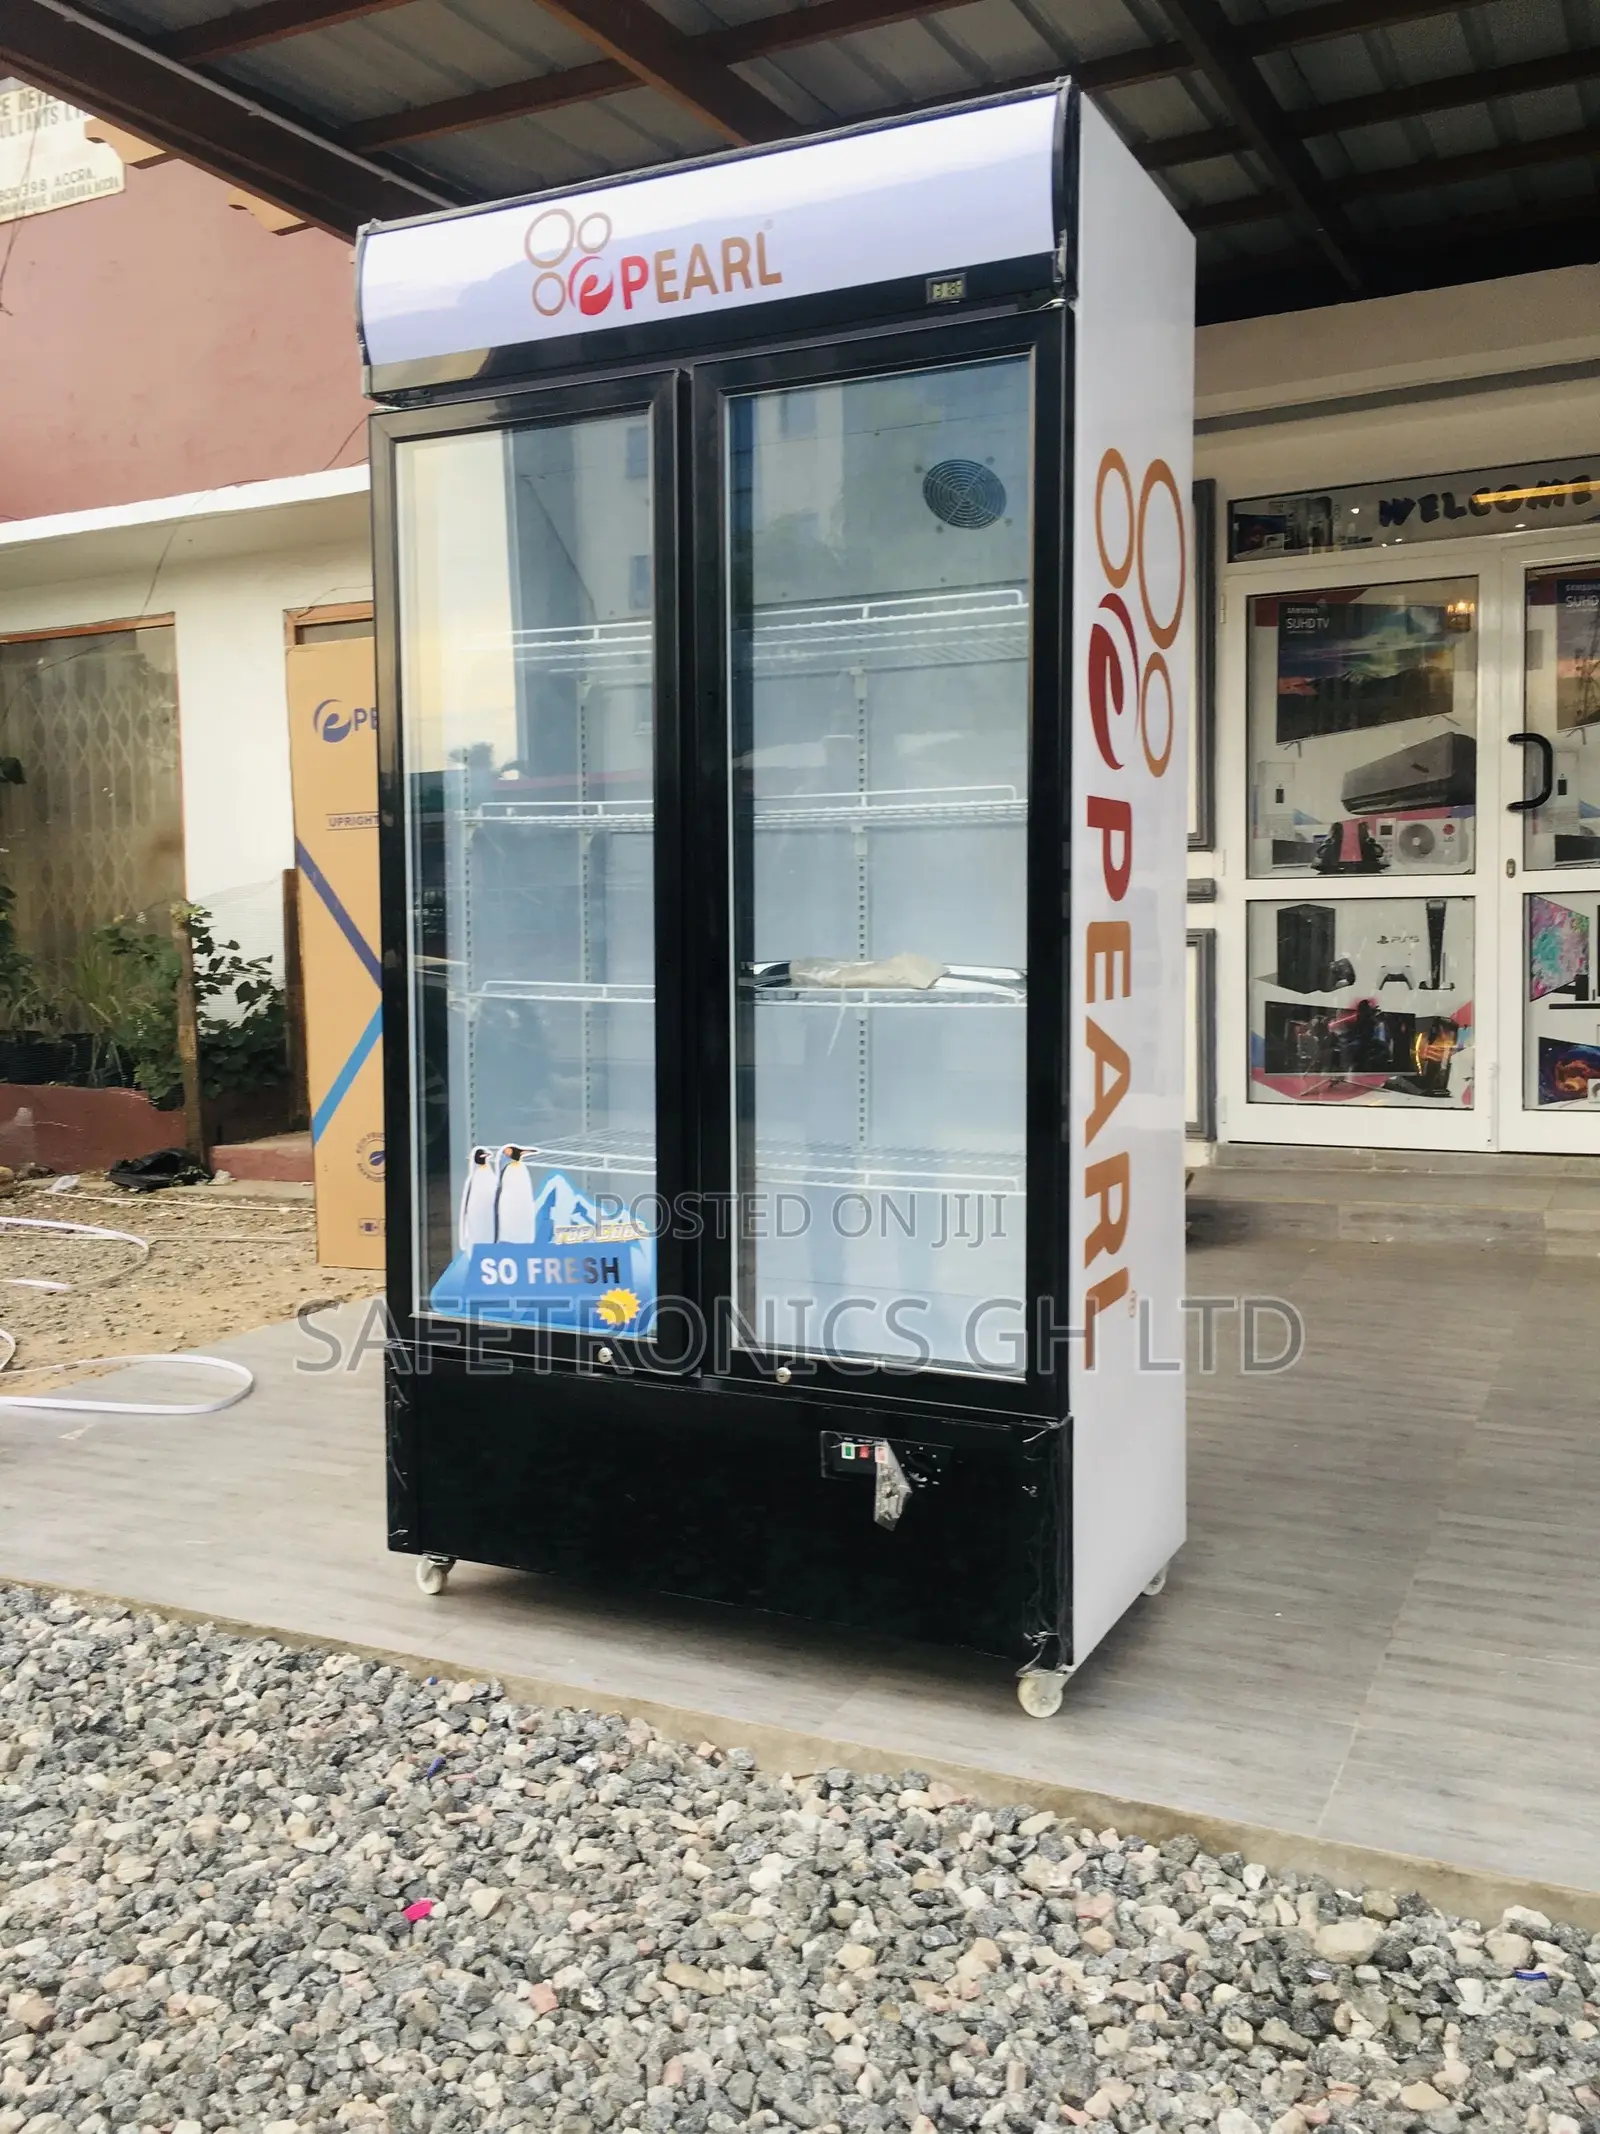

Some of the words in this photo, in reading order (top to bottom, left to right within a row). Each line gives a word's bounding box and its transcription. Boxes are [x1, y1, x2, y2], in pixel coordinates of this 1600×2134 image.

[619, 231, 783, 311] PEARL
[1378, 474, 1594, 527] WELCOME
[328, 815, 380, 828] UPRIGHT
[1084, 794, 1133, 1371] PEARL
[480, 1256, 519, 1286] SO
[527, 1255, 620, 1285] FRESH
